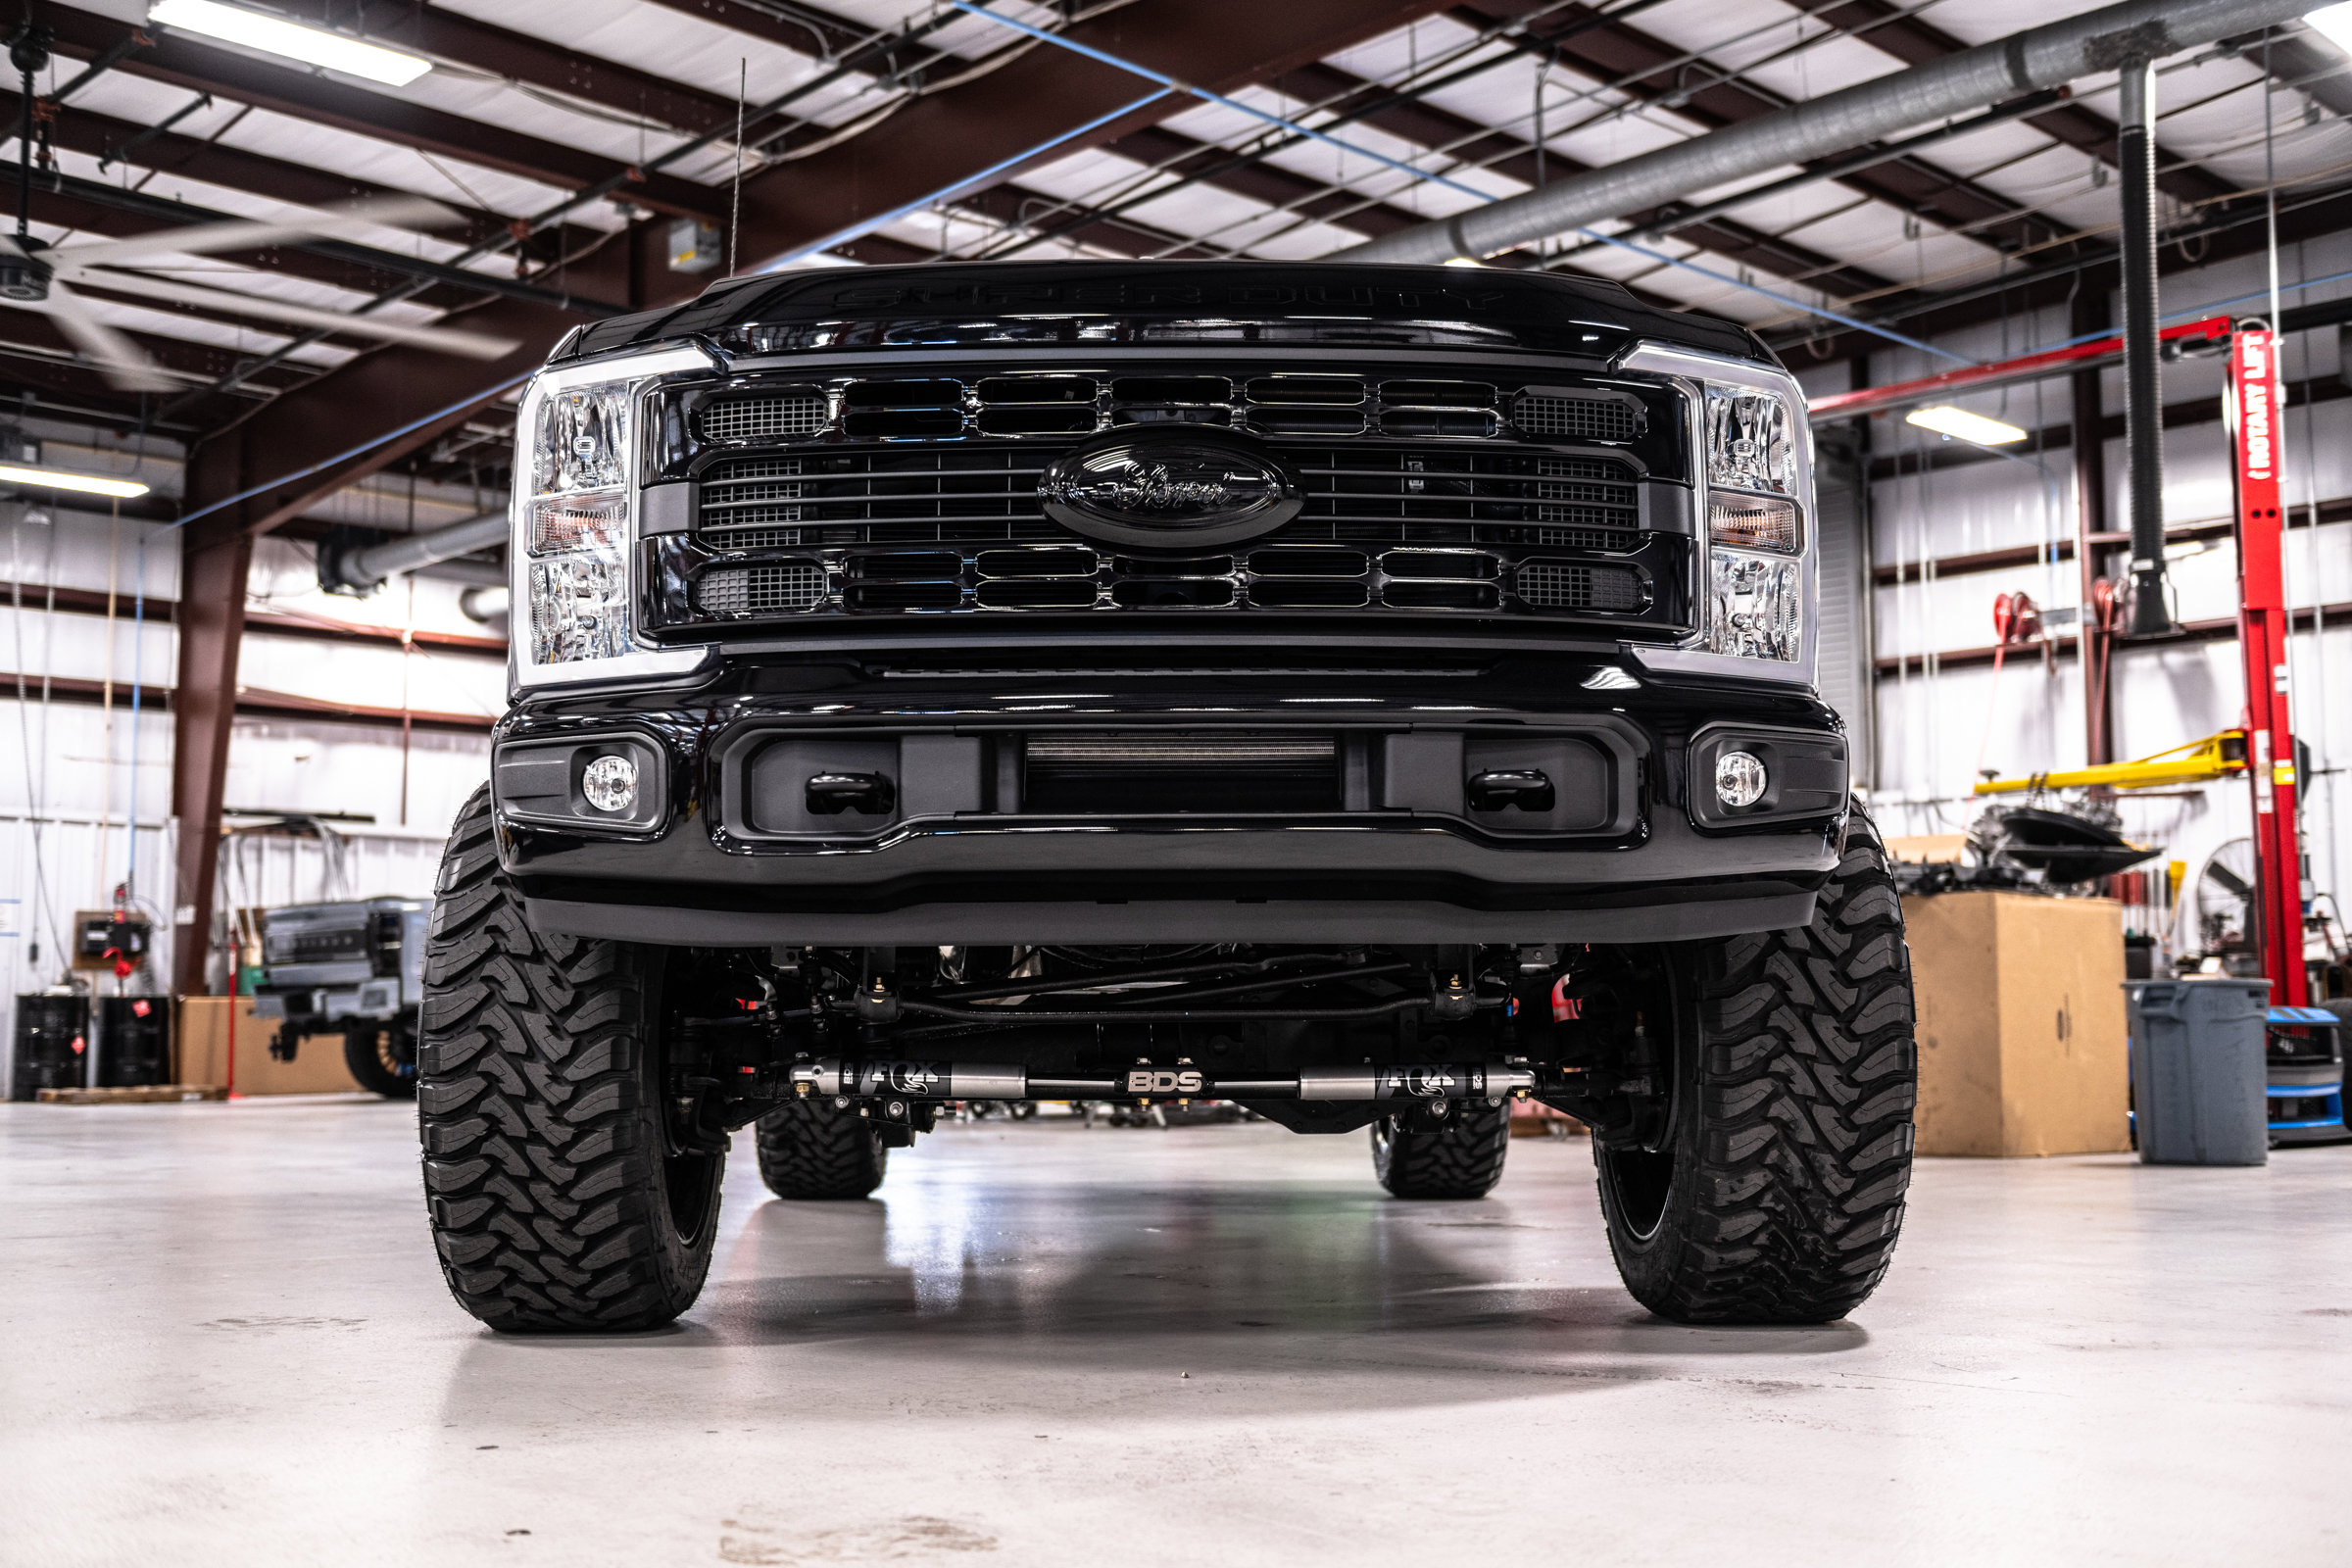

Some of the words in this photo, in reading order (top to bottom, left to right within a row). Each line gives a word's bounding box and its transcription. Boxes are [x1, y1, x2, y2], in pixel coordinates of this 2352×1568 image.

[833, 284, 1201, 309] SUPER
[1228, 285, 1504, 310] DUTY
[2242, 333, 2267, 379] LIFT
[2244, 383, 2271, 468] ROTARY
[1111, 460, 1237, 509] Ford
[871, 1060, 939, 1095] FOX
[1128, 1071, 1202, 1092] BDS
[1388, 1064, 1455, 1097] FOX
